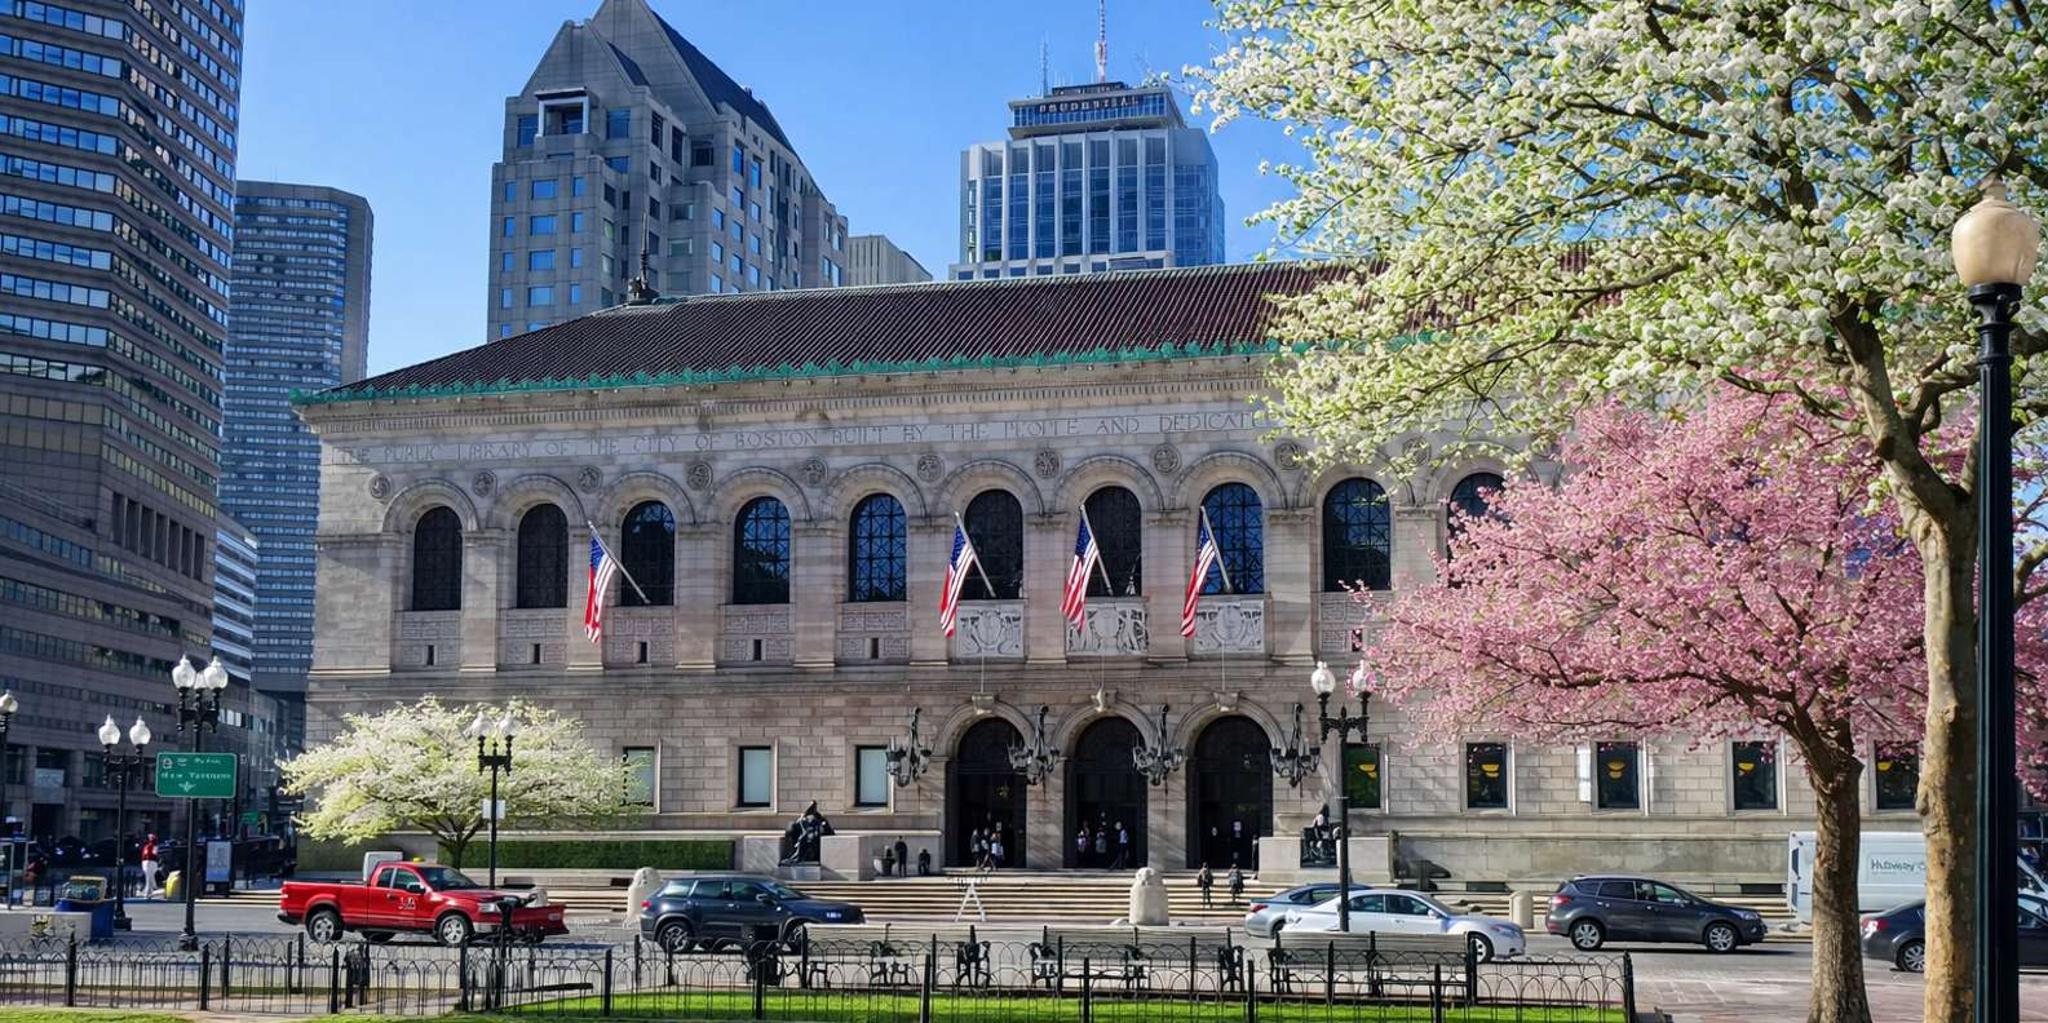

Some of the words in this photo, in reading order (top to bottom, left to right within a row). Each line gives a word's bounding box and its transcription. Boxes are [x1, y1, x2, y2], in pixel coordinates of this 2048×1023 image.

[545, 441, 569, 456] OF
[588, 438, 621, 455] THE
[633, 435, 679, 453] CITY
[695, 434, 722, 450] OF
[735, 430, 818, 448] BOSTON
[903, 424, 928, 440] BY
[946, 423, 991, 440] THE
[1096, 416, 1140, 434] AND
